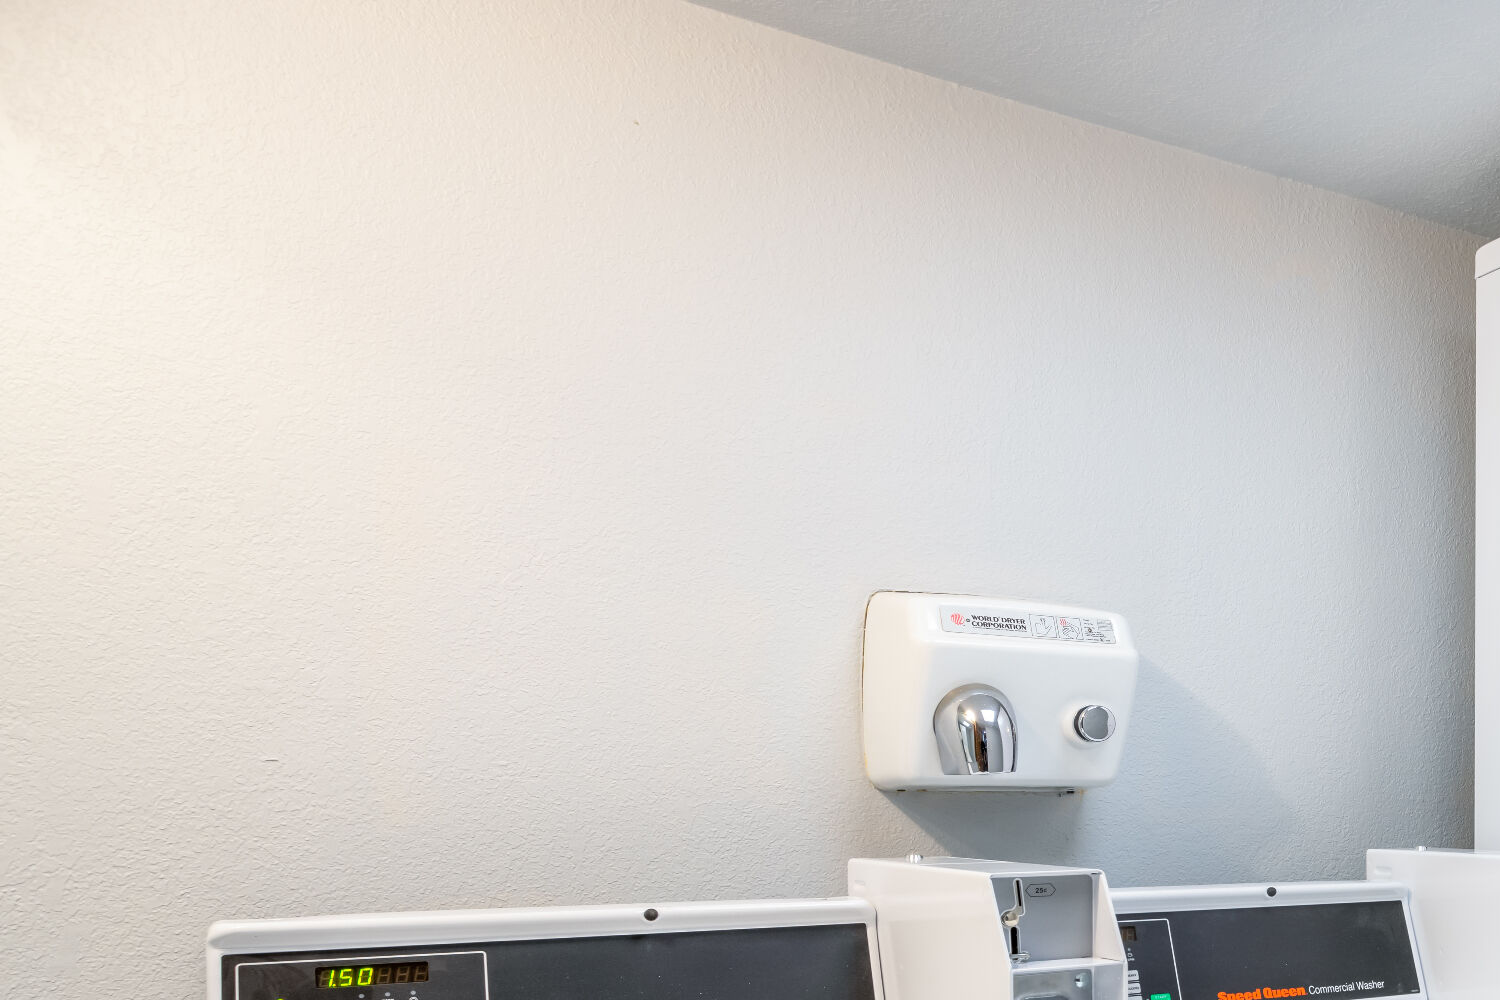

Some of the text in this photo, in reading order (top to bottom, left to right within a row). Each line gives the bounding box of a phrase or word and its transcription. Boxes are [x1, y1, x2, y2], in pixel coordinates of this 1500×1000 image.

[971, 614, 1026, 625] WORLD DRYER
[971, 621, 1027, 630] CORPORATION
[328, 967, 374, 988] 1.50
[1262, 986, 1307, 999] Queen
[1308, 982, 1355, 995] Commercial
[1356, 980, 1385, 991] Washer
